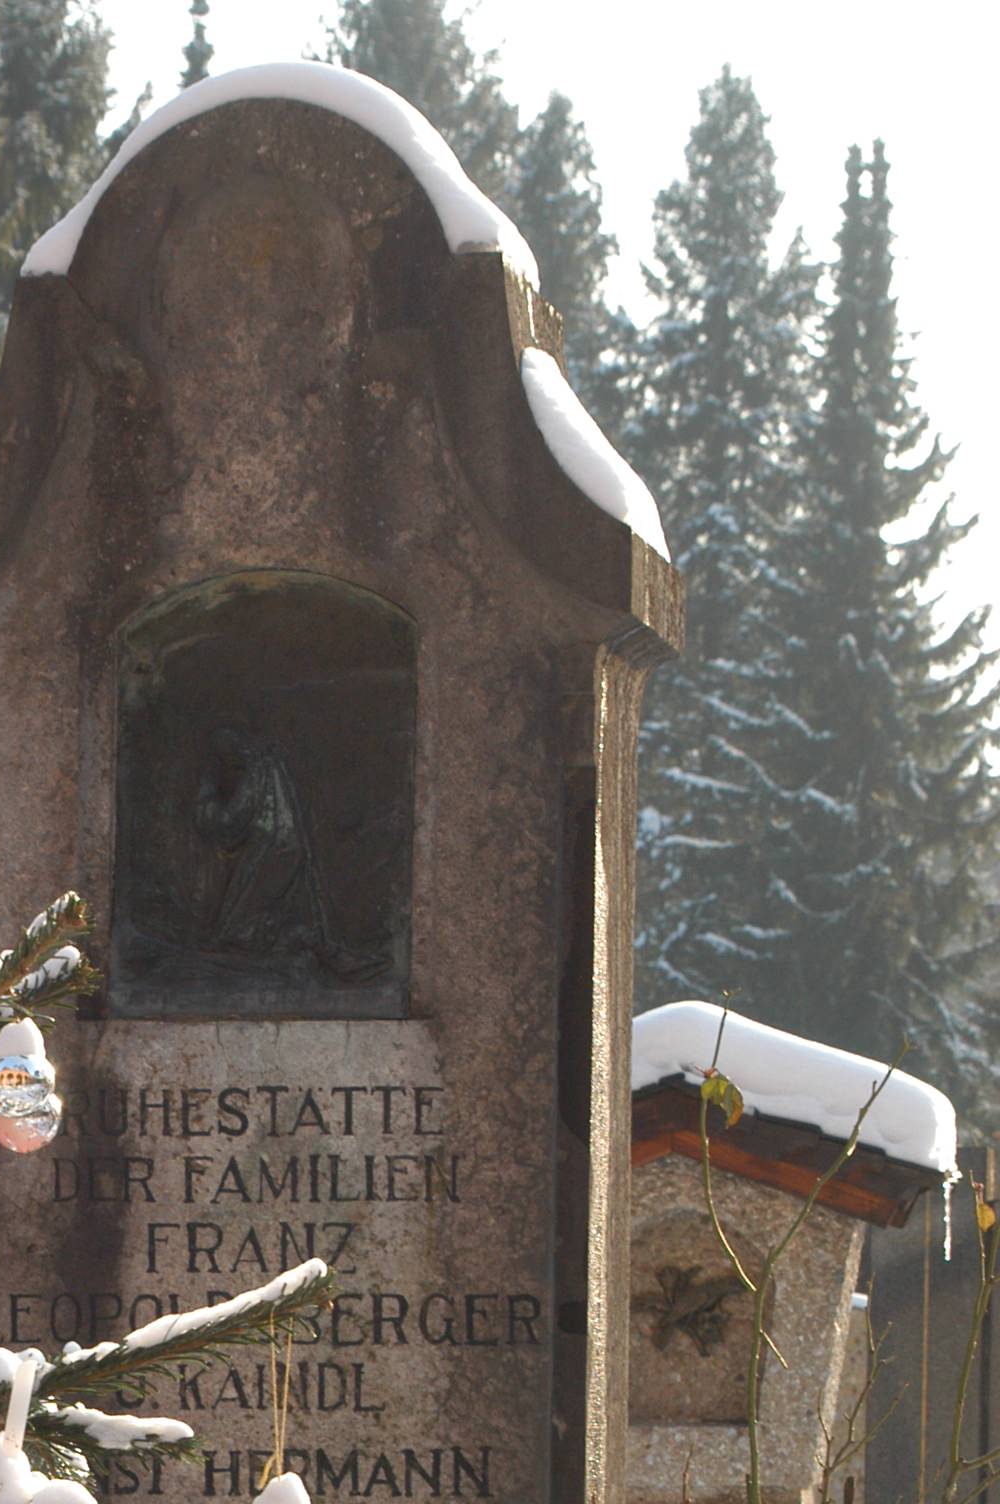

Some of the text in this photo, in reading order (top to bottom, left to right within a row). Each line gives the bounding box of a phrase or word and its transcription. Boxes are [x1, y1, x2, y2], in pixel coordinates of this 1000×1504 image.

[60, 1085, 445, 1138] RUHESTÄTTE
[52, 1153, 462, 1204] DER FAMILIEN
[145, 1221, 358, 1274] FRANZ
[177, 1360, 386, 1413] KAINDL
